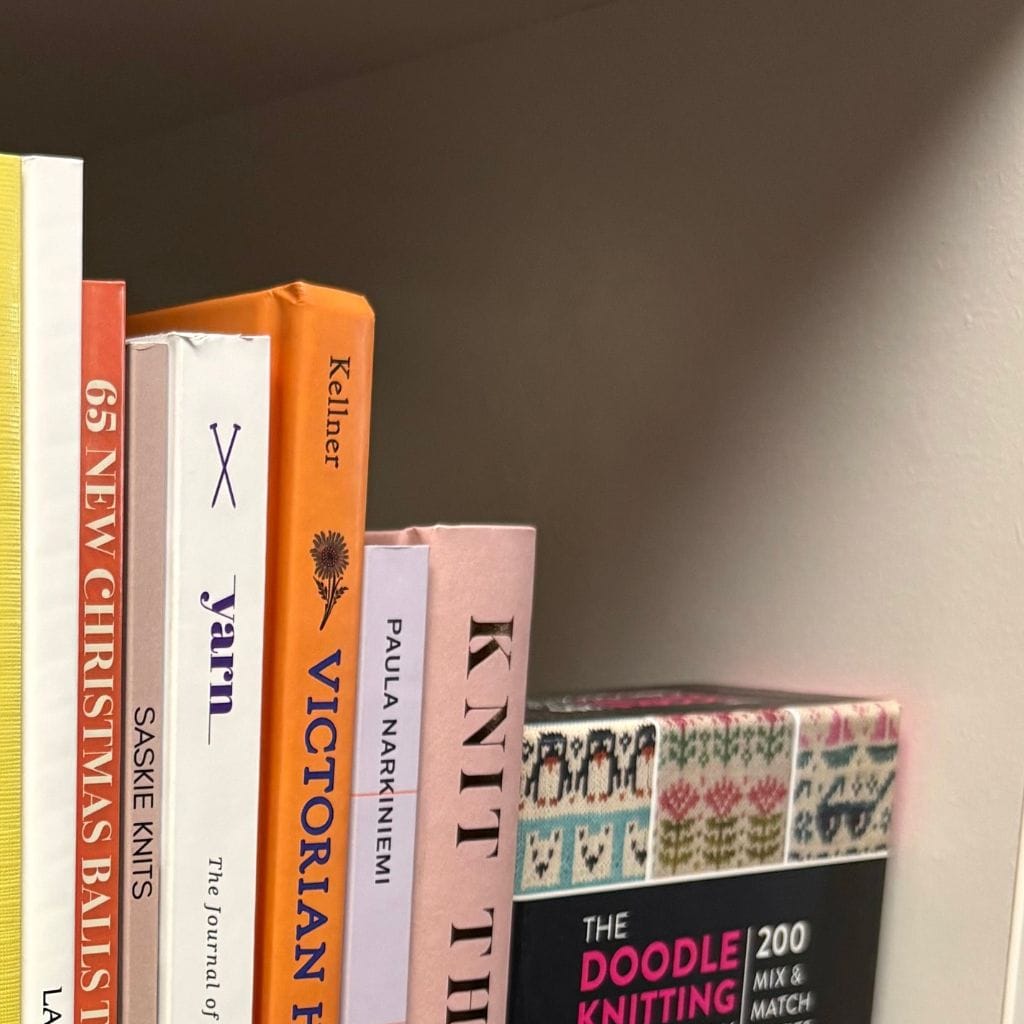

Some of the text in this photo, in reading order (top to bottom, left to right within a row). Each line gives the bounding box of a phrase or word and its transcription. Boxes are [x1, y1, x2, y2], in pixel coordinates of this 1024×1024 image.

[84, 379, 118, 433] 65
[325, 356, 351, 469] Kellner
[84, 447, 117, 560] NEW
[81, 568, 115, 843] CHRISTMAS
[199, 575, 236, 745] yarn
[375, 619, 402, 884] PAULA NARKINIEMI
[456, 615, 514, 859] KNIT
[131, 706, 155, 900] SASKIE KNITS
[293, 649, 341, 982] VICTORIAN
[80, 856, 112, 993] BALLS
[208, 857, 222, 897] The
[583, 911, 630, 943] THE
[203, 902, 222, 991] Journal
[580, 929, 742, 992] DOODLE
[753, 964, 804, 991] MIX &
[756, 920, 810, 959] 200
[201, 998, 219, 1021] of
[750, 991, 813, 1022] MATCH
